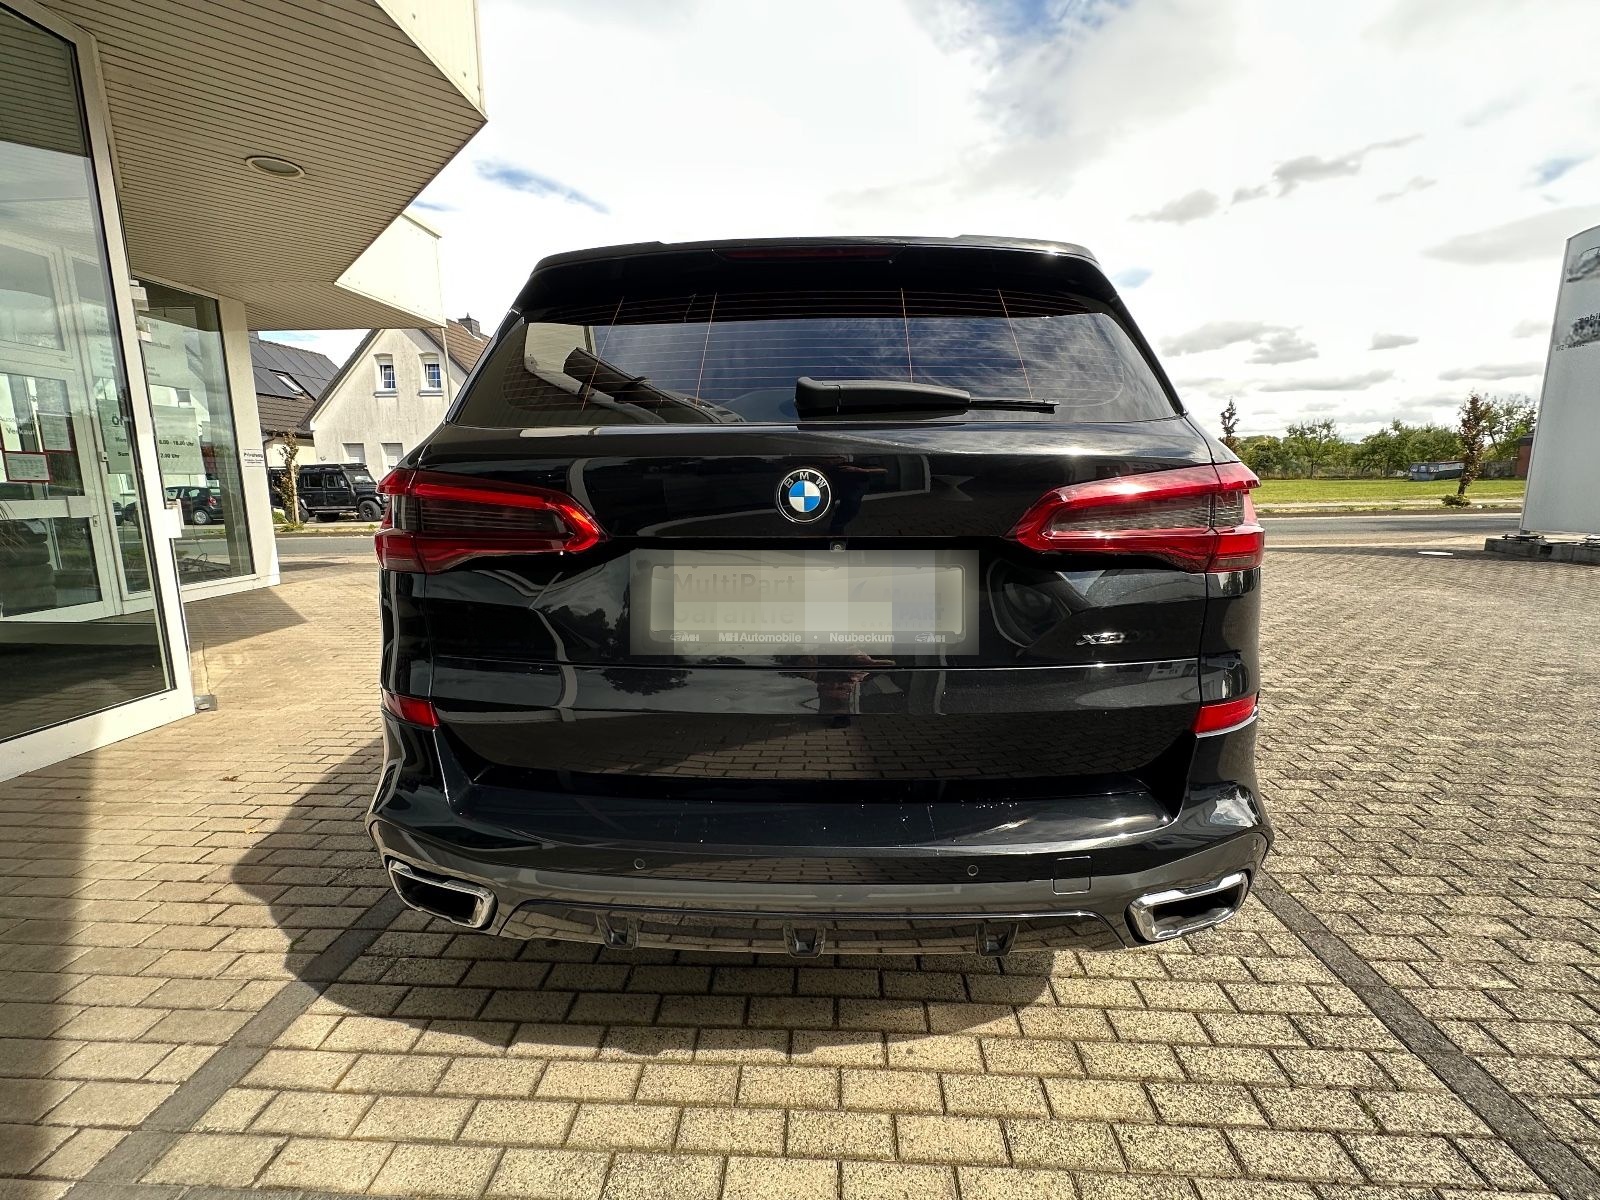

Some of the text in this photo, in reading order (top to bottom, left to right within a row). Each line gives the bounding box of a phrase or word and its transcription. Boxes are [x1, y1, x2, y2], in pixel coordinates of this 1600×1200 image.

[784, 471, 827, 489] BMW
[674, 573, 795, 595] MultiPart
[718, 632, 895, 642] MH Automobile Neubeckum
